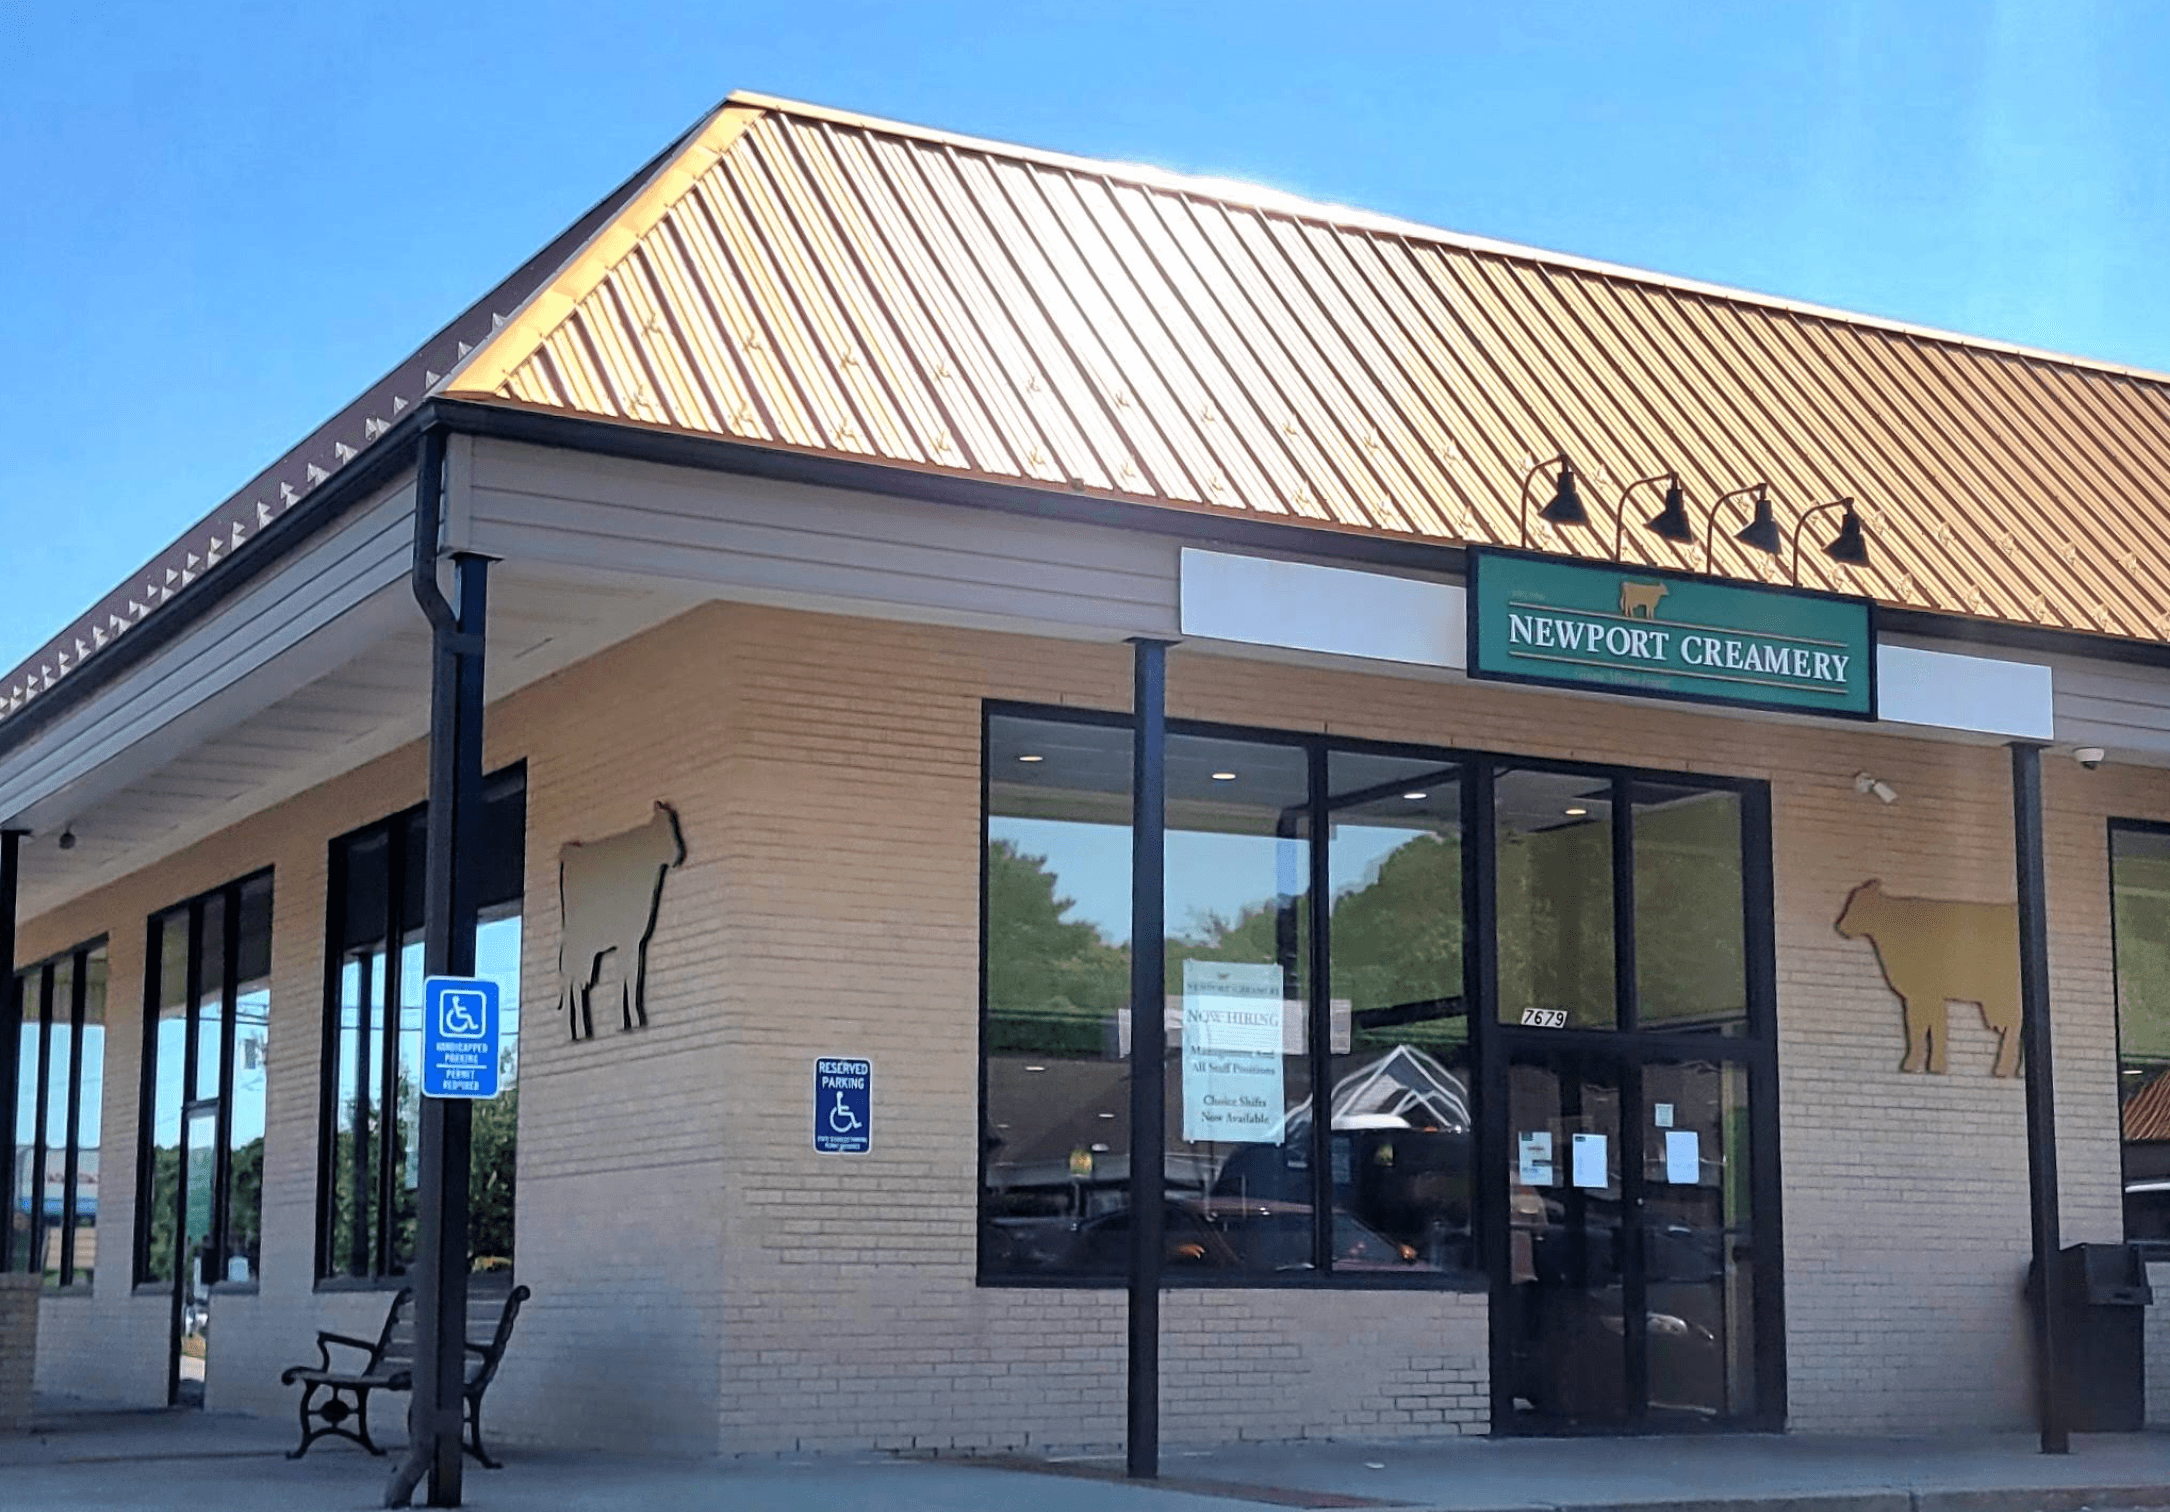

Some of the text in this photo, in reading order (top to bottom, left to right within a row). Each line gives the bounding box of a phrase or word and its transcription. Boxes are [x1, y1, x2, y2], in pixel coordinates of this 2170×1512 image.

[1508, 613, 1849, 683] NEWPORT CREAMERY
[1187, 1009, 1280, 1027] NOW HIRING
[1524, 1009, 1564, 1026] 7679
[819, 1061, 869, 1075] RESERVED
[1193, 1061, 1206, 1073] All
[822, 1076, 865, 1090] PARKING
[1203, 1094, 1267, 1108] Choice Shifts
[1202, 1111, 1270, 1124] Now Available
